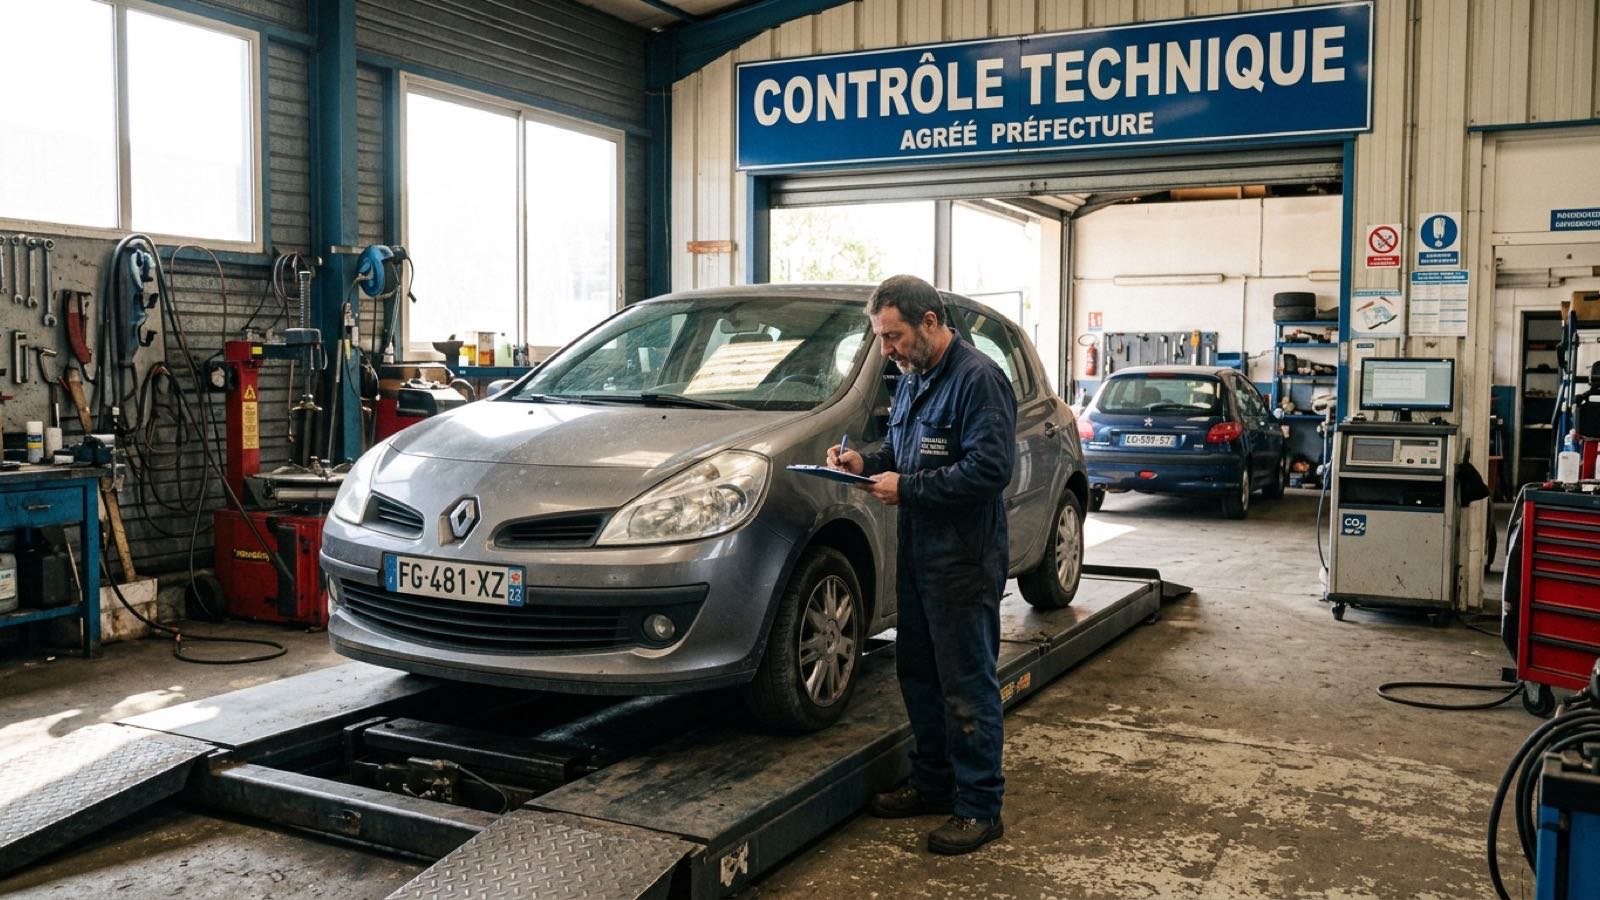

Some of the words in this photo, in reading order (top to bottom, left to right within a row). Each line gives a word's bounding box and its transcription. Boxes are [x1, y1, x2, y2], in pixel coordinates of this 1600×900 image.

[753, 52, 1005, 126] CONTRÔLE
[1021, 25, 1346, 105] TECHNIQUE
[900, 119, 977, 151] AGRÉÉ
[991, 111, 1154, 144] PRÉFECTURE
